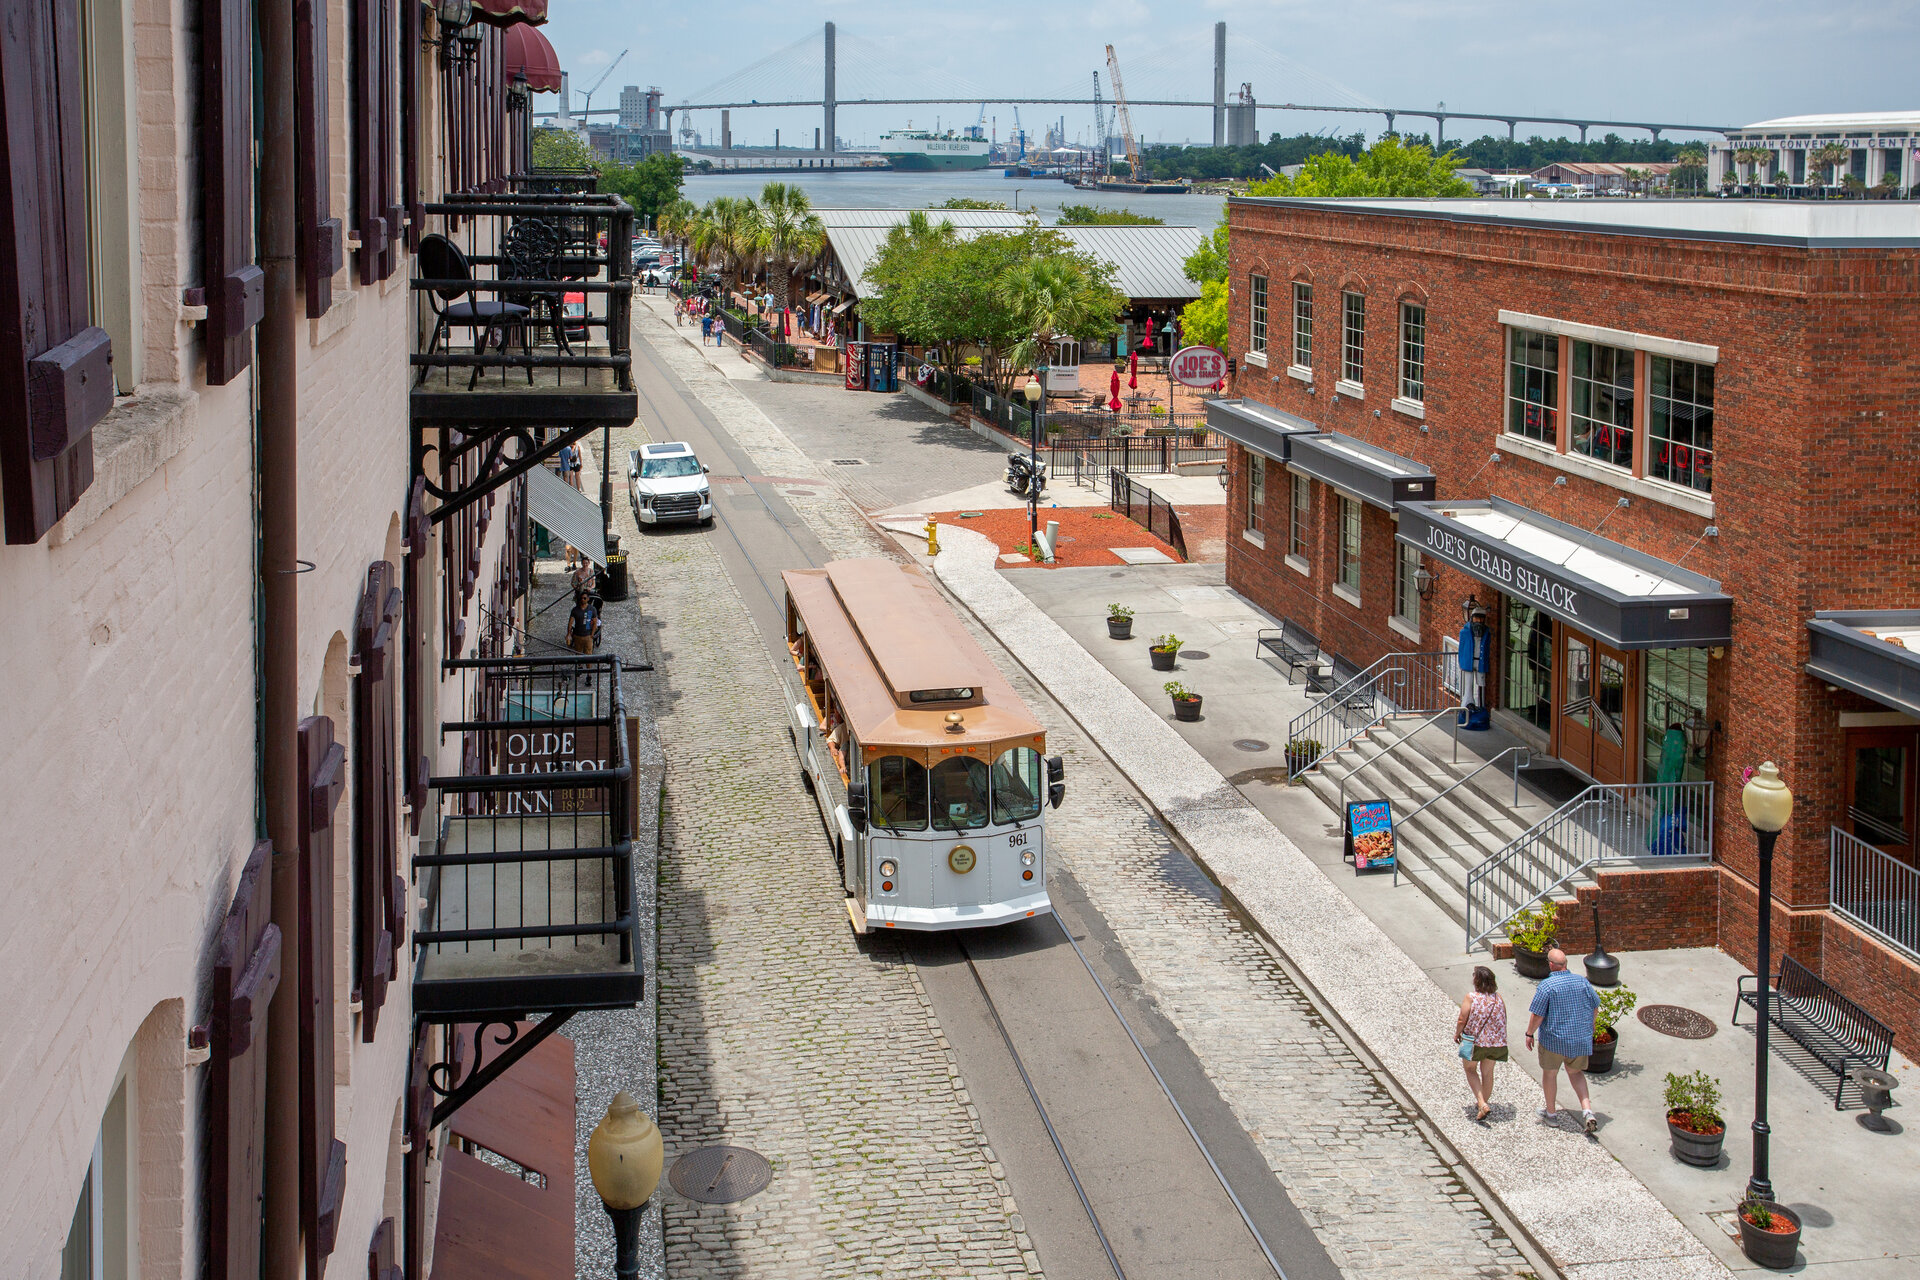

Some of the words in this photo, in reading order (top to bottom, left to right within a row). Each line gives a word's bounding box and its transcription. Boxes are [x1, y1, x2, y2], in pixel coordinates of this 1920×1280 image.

[1729, 140, 1775, 149] SAVANNAH
[1178, 355, 1221, 371] JOE'S
[1179, 371, 1197, 379] CRAB
[1199, 371, 1221, 379] SHACK
[1427, 525, 1466, 561] JOE'S
[1470, 545, 1512, 582] CRAB
[1516, 566, 1578, 615] SHACK
[506, 732, 574, 757] OLDE
[506, 789, 554, 814] INN
[562, 788, 595, 800] BUILT
[1009, 832, 1028, 848] 961
